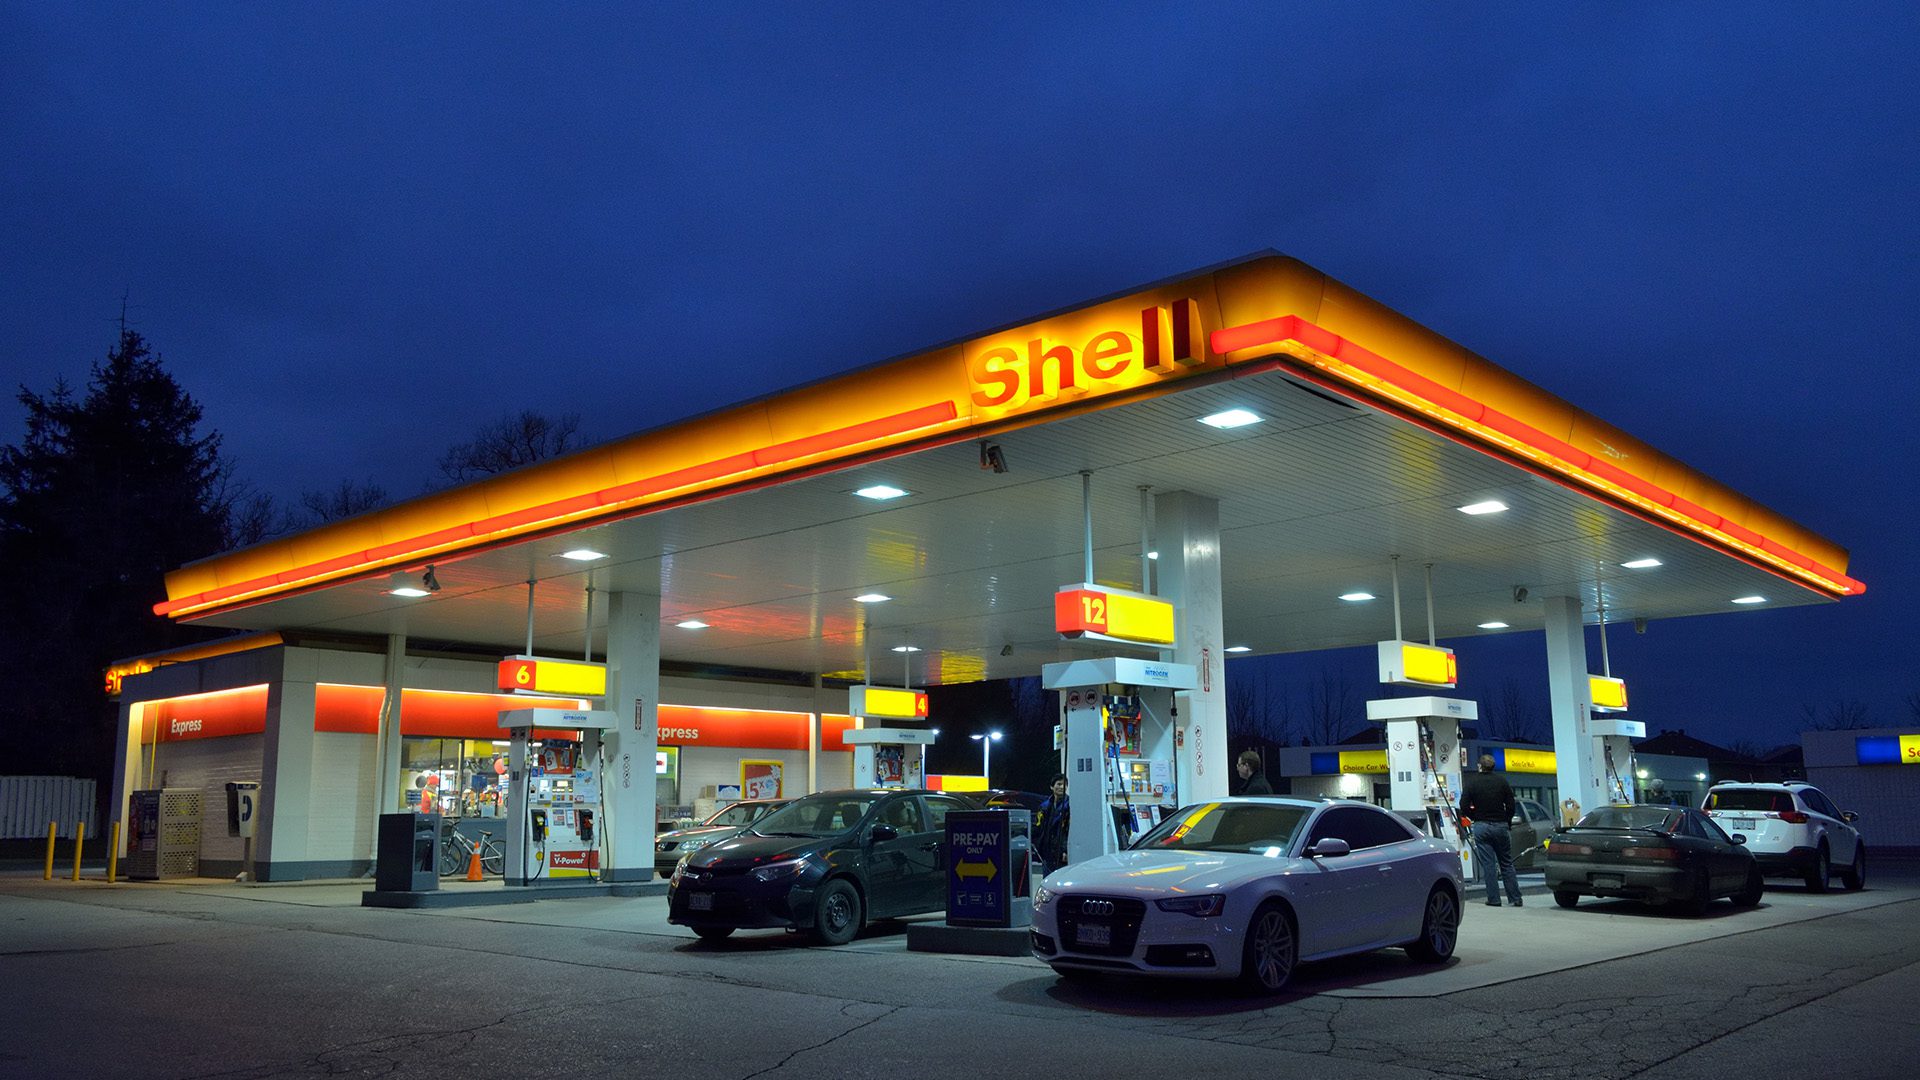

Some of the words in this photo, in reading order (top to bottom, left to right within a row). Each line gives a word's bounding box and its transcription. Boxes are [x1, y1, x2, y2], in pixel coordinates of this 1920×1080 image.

[1082, 596, 1105, 625] 12
[516, 665, 530, 685] 6
[1447, 658, 1455, 678] 10
[918, 697, 926, 713] 4
[171, 719, 202, 736] Express
[657, 727, 699, 741] xpress
[953, 833, 999, 846] PRE-PAY
